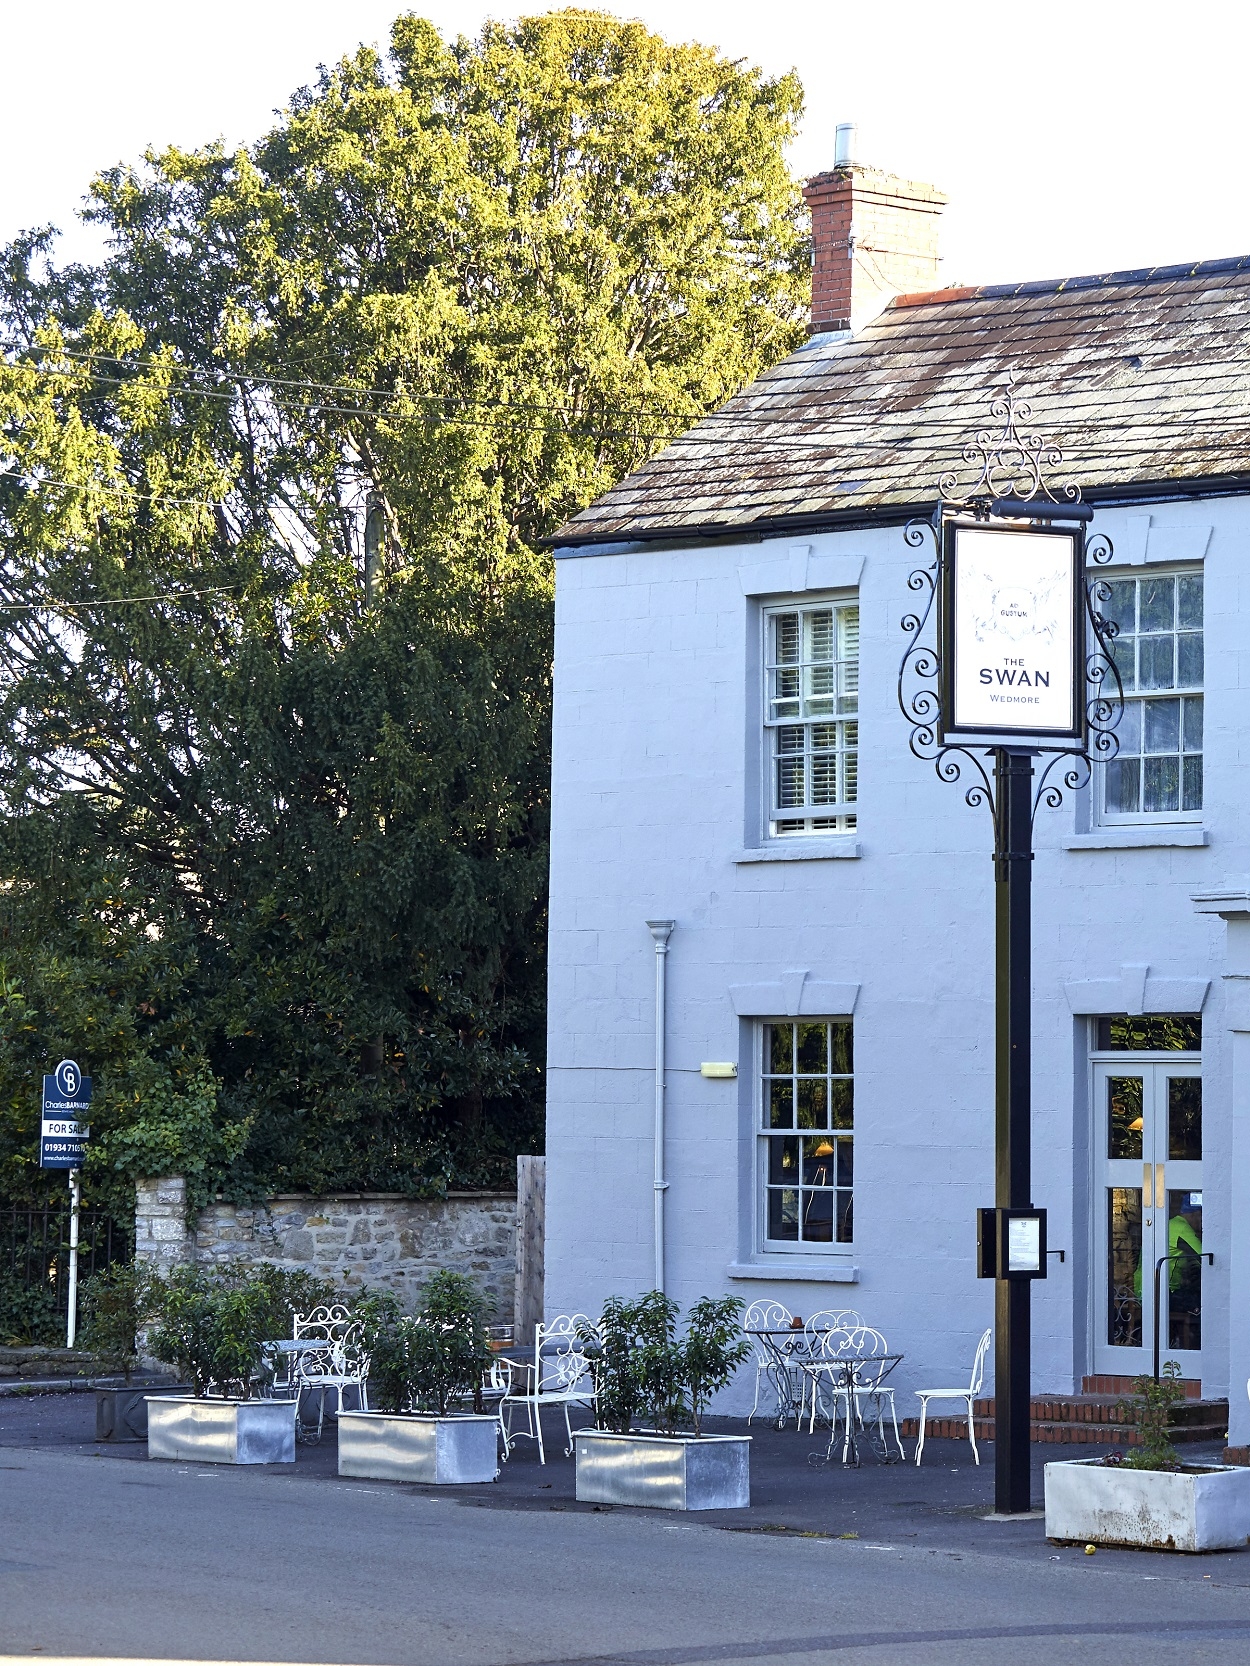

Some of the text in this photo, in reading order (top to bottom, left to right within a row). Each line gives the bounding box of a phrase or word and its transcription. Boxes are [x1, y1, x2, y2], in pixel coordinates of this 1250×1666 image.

[1004, 658, 1024, 666] THE
[979, 669, 1050, 687] SWAN
[49, 1124, 66, 1133] FOR
[45, 1144, 66, 1152] 01934
